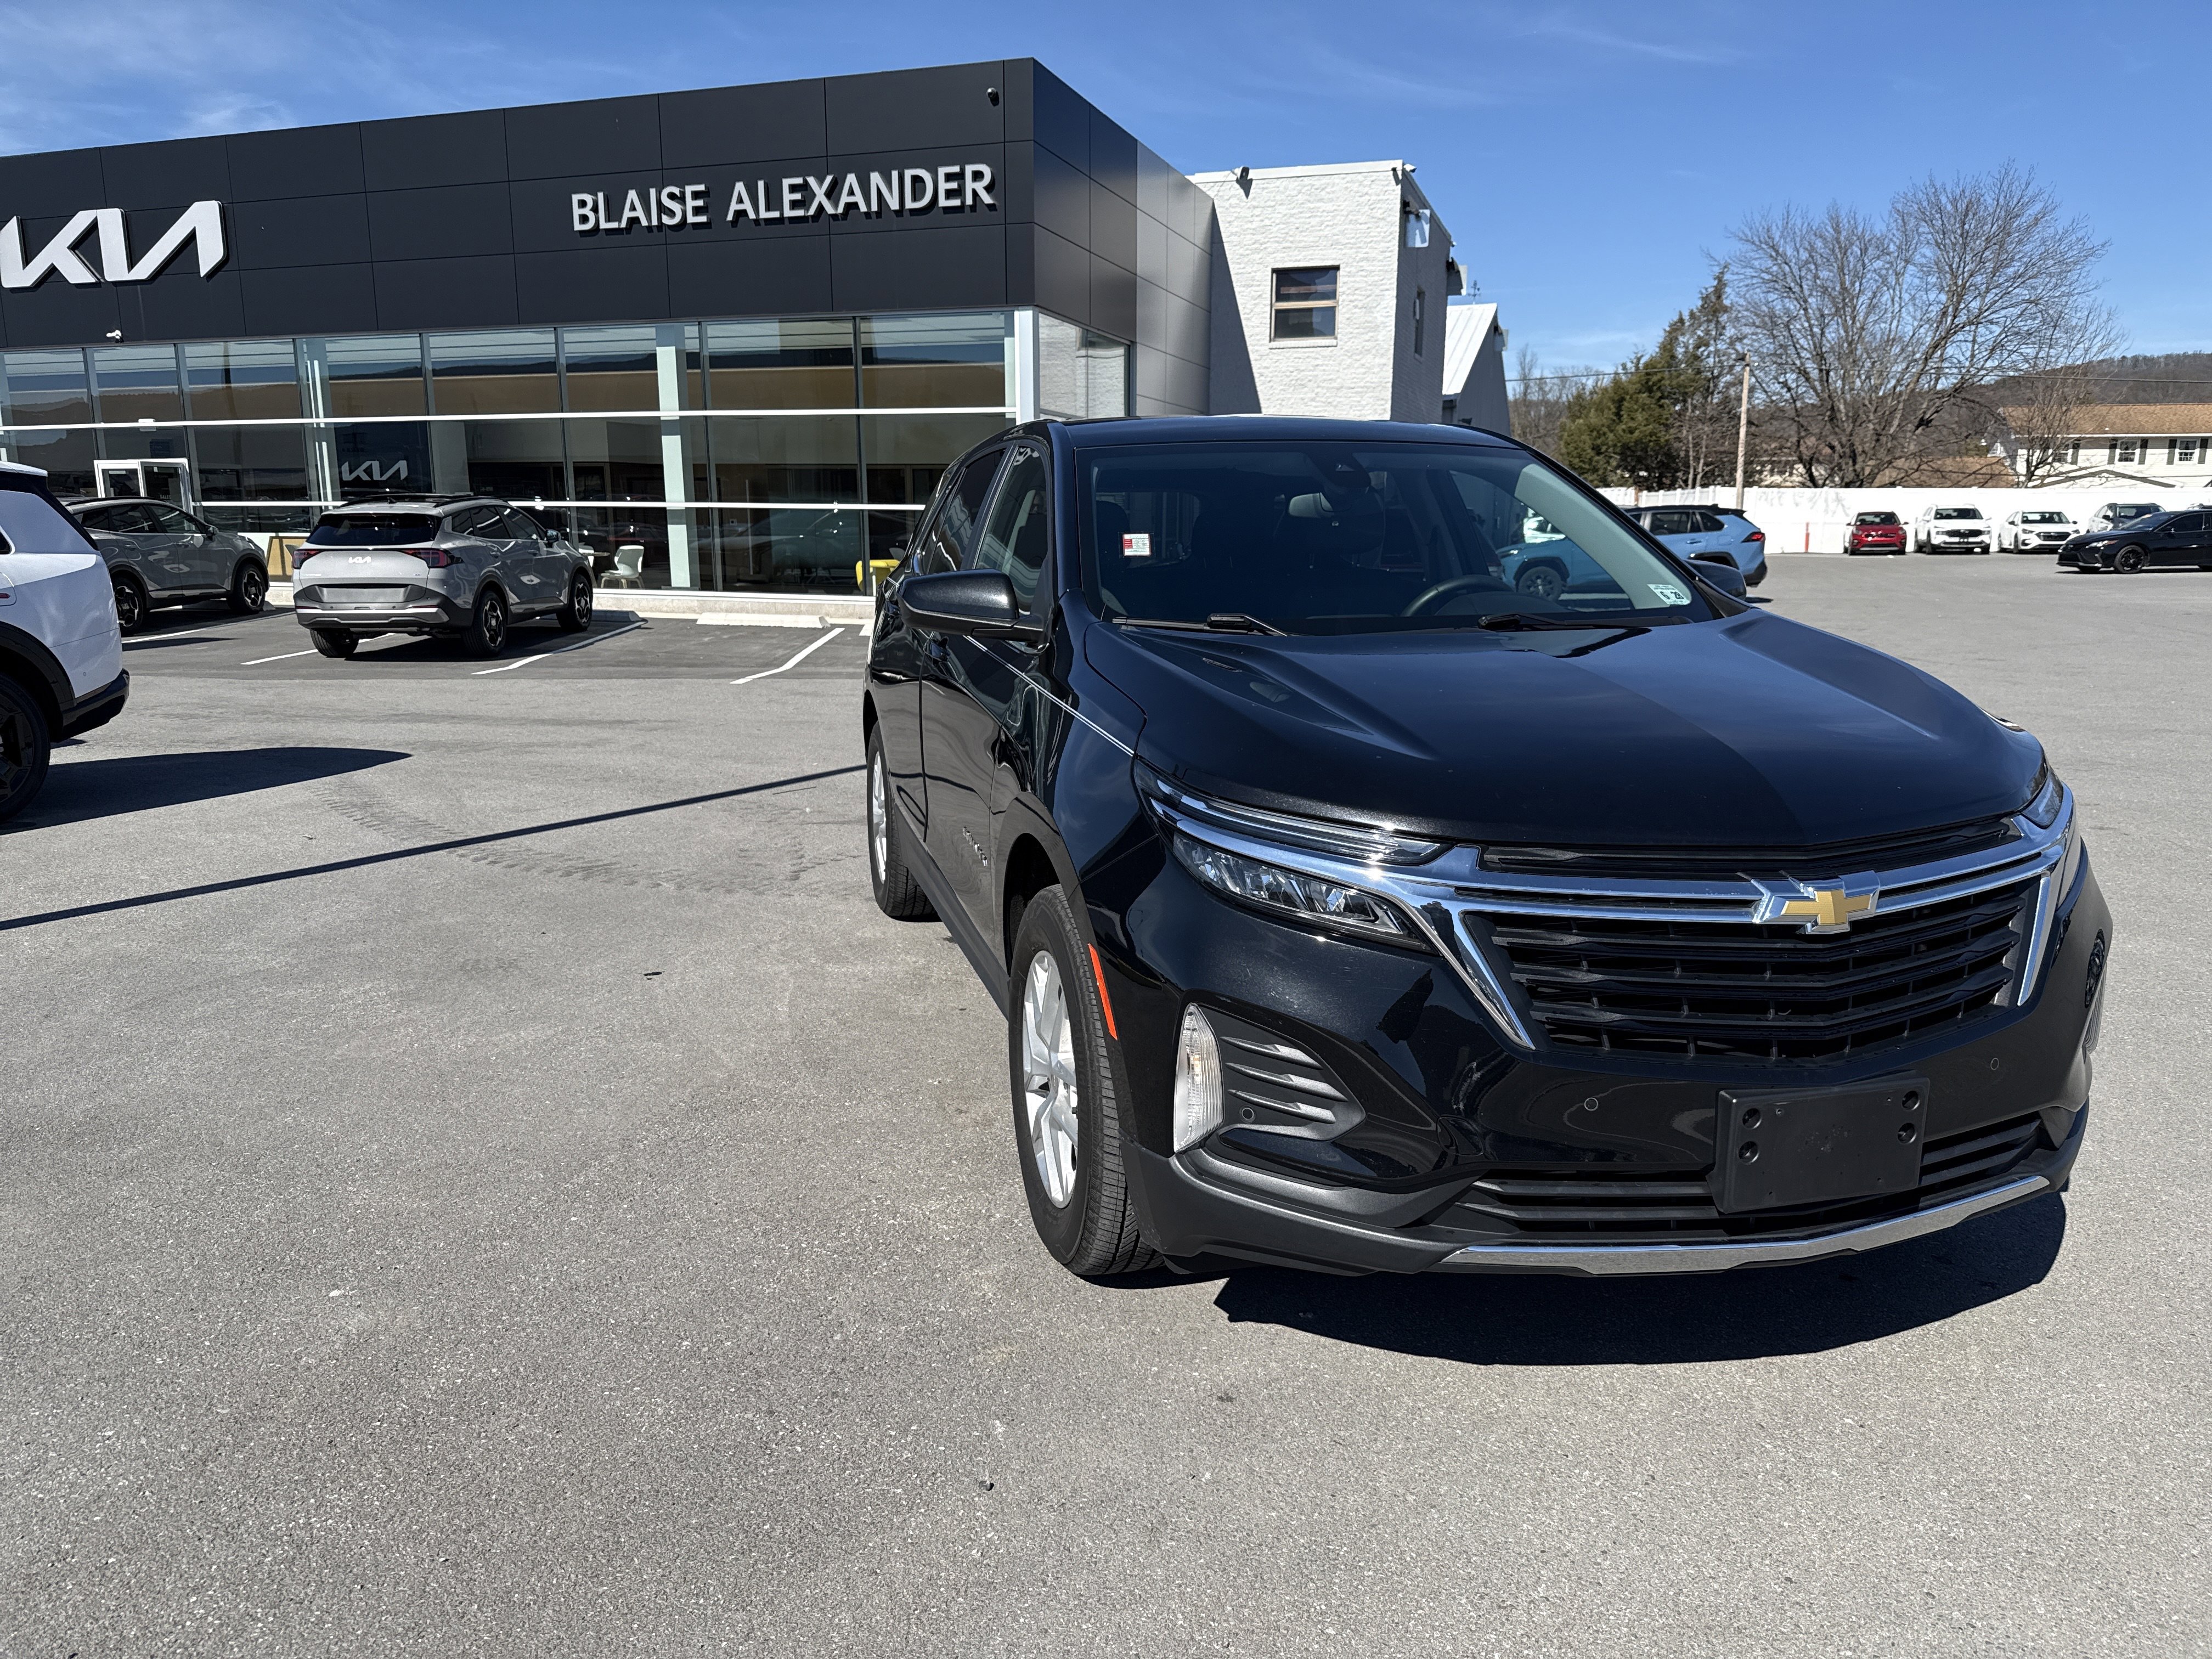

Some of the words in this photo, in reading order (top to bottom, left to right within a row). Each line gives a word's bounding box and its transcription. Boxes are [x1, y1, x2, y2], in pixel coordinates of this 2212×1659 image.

[572, 183, 708, 231] BLAISE
[726, 163, 995, 221] ALEXANDER
[0, 200, 224, 288] KIA
[341, 460, 408, 481] KIA
